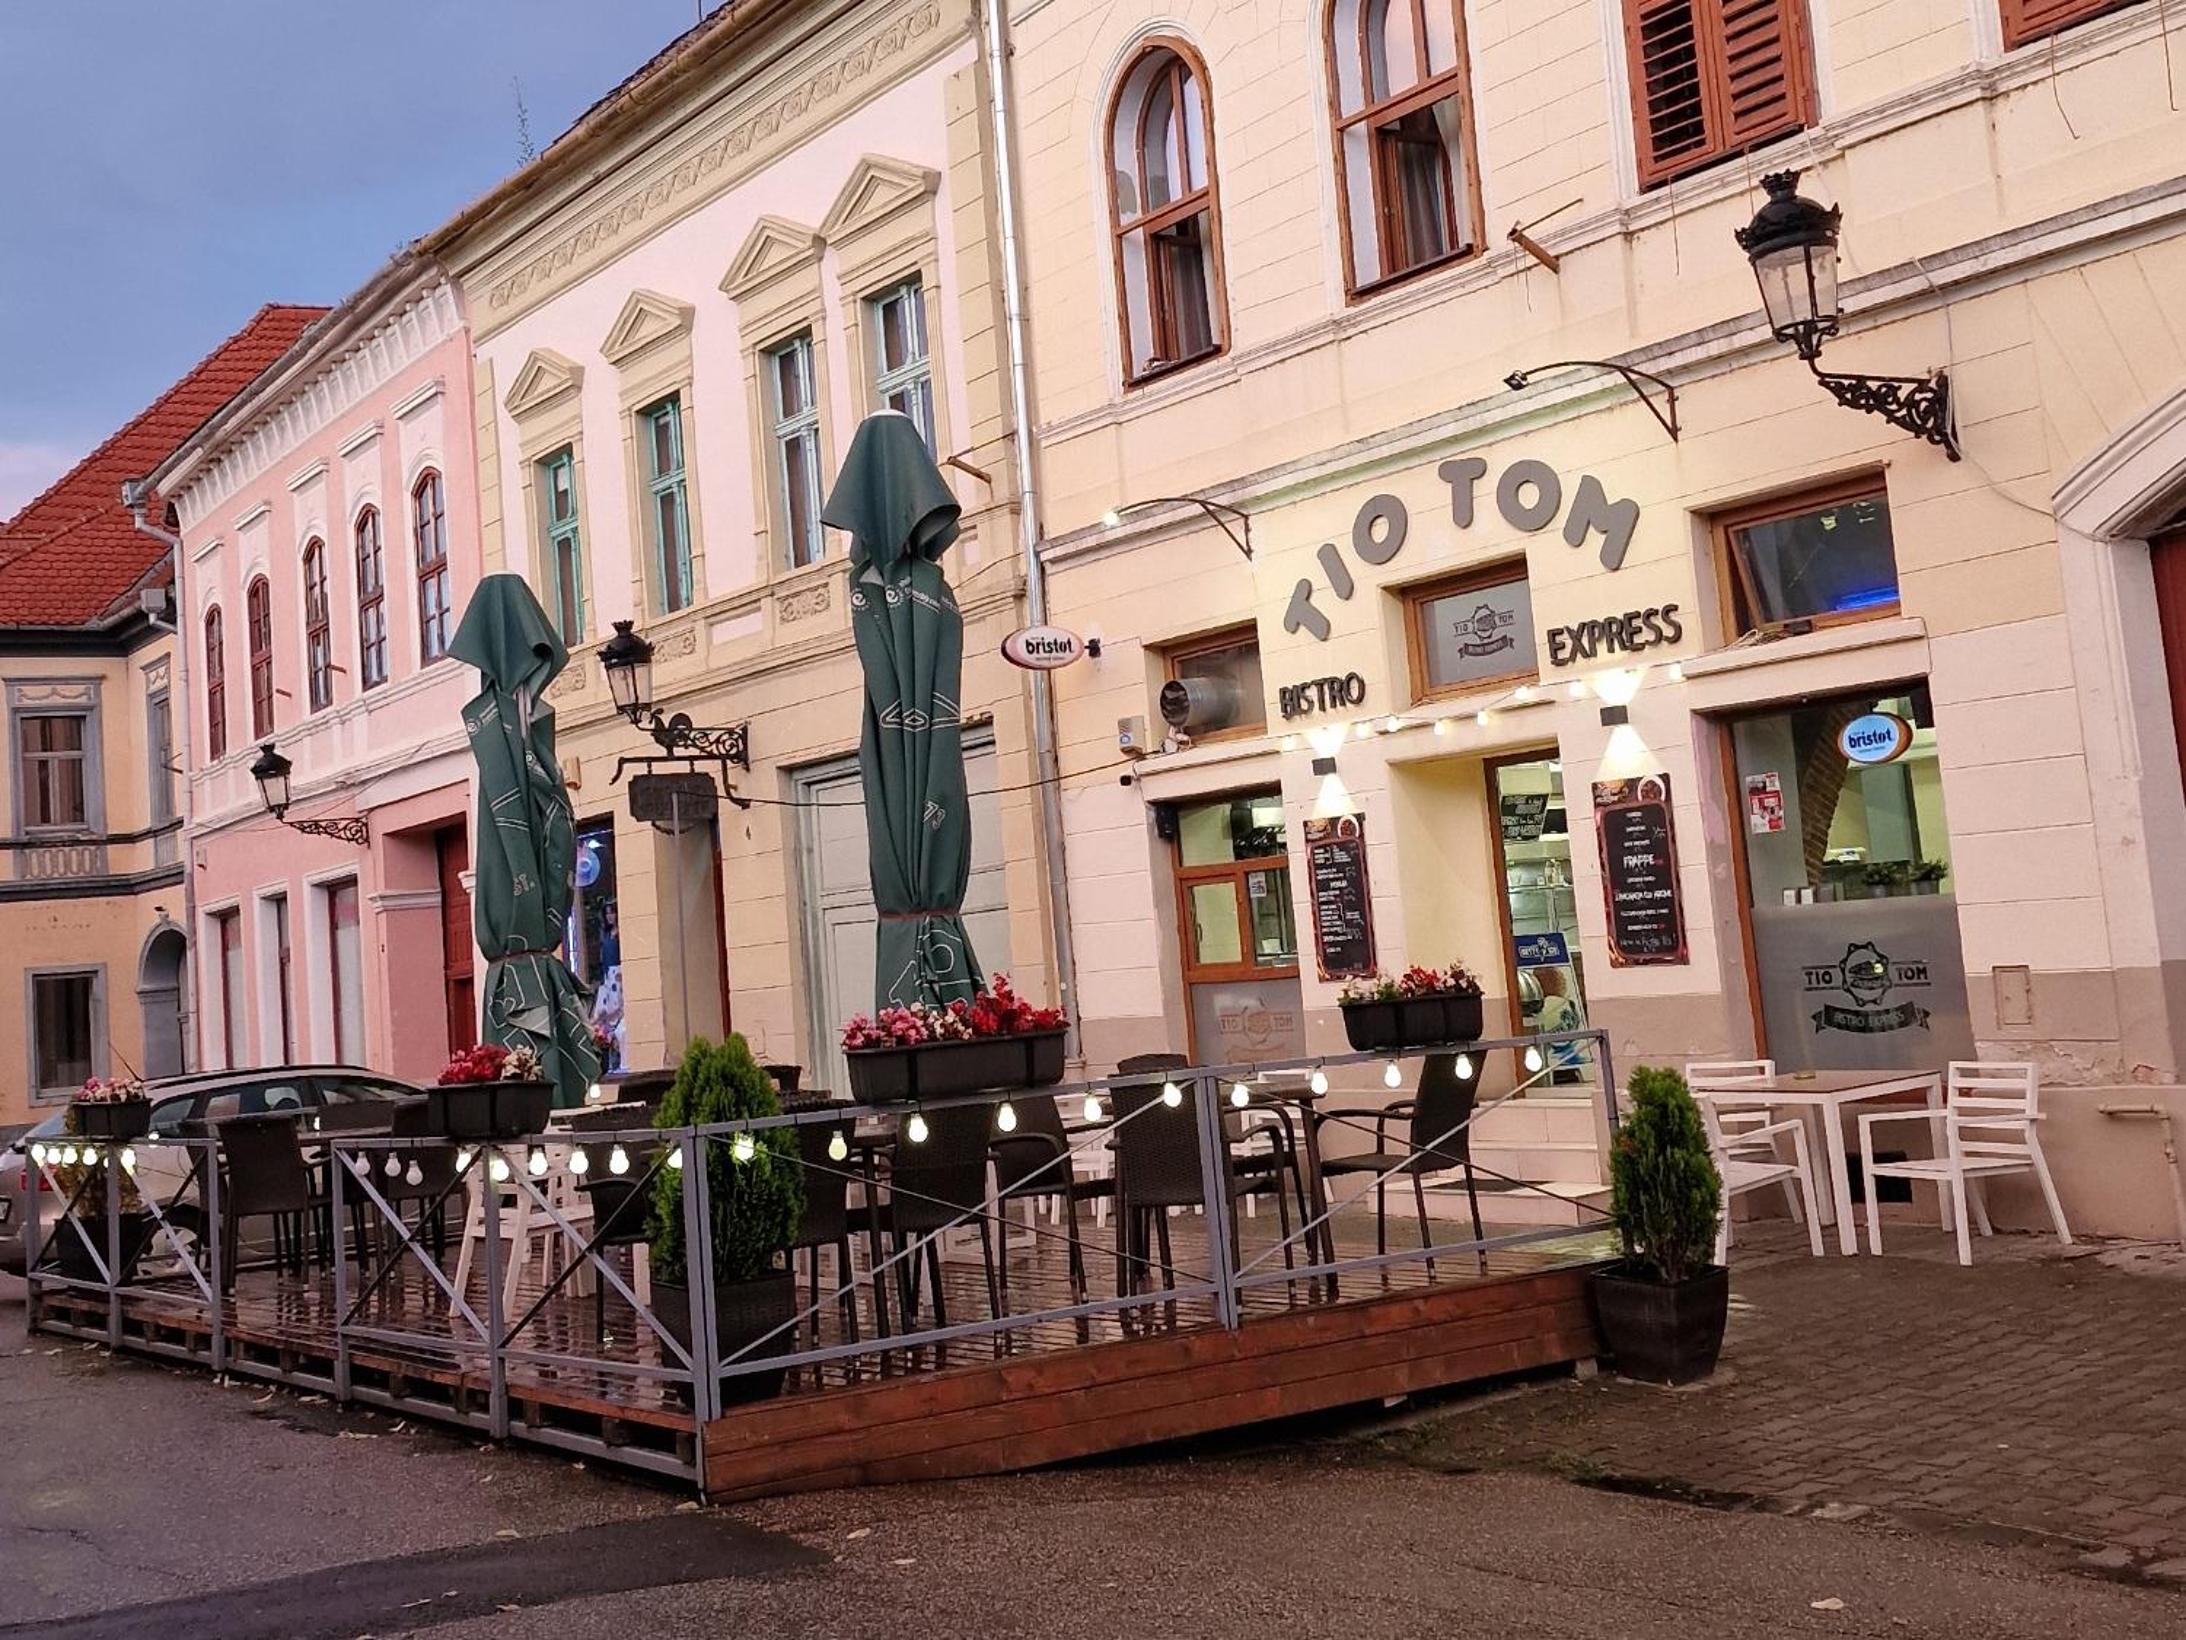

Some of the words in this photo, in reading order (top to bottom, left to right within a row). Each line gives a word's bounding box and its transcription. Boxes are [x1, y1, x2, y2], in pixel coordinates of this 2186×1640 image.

[1283, 493, 1408, 642] TIO
[1437, 458, 1641, 572] TOM
[1025, 637, 1074, 655] bristot
[1546, 603, 1683, 666] EXPRESS
[1278, 671, 1367, 721] BISTRO
[1848, 728, 1893, 748] bristot
[1805, 971, 1833, 985] TIO
[1895, 966, 1928, 980] TOM
